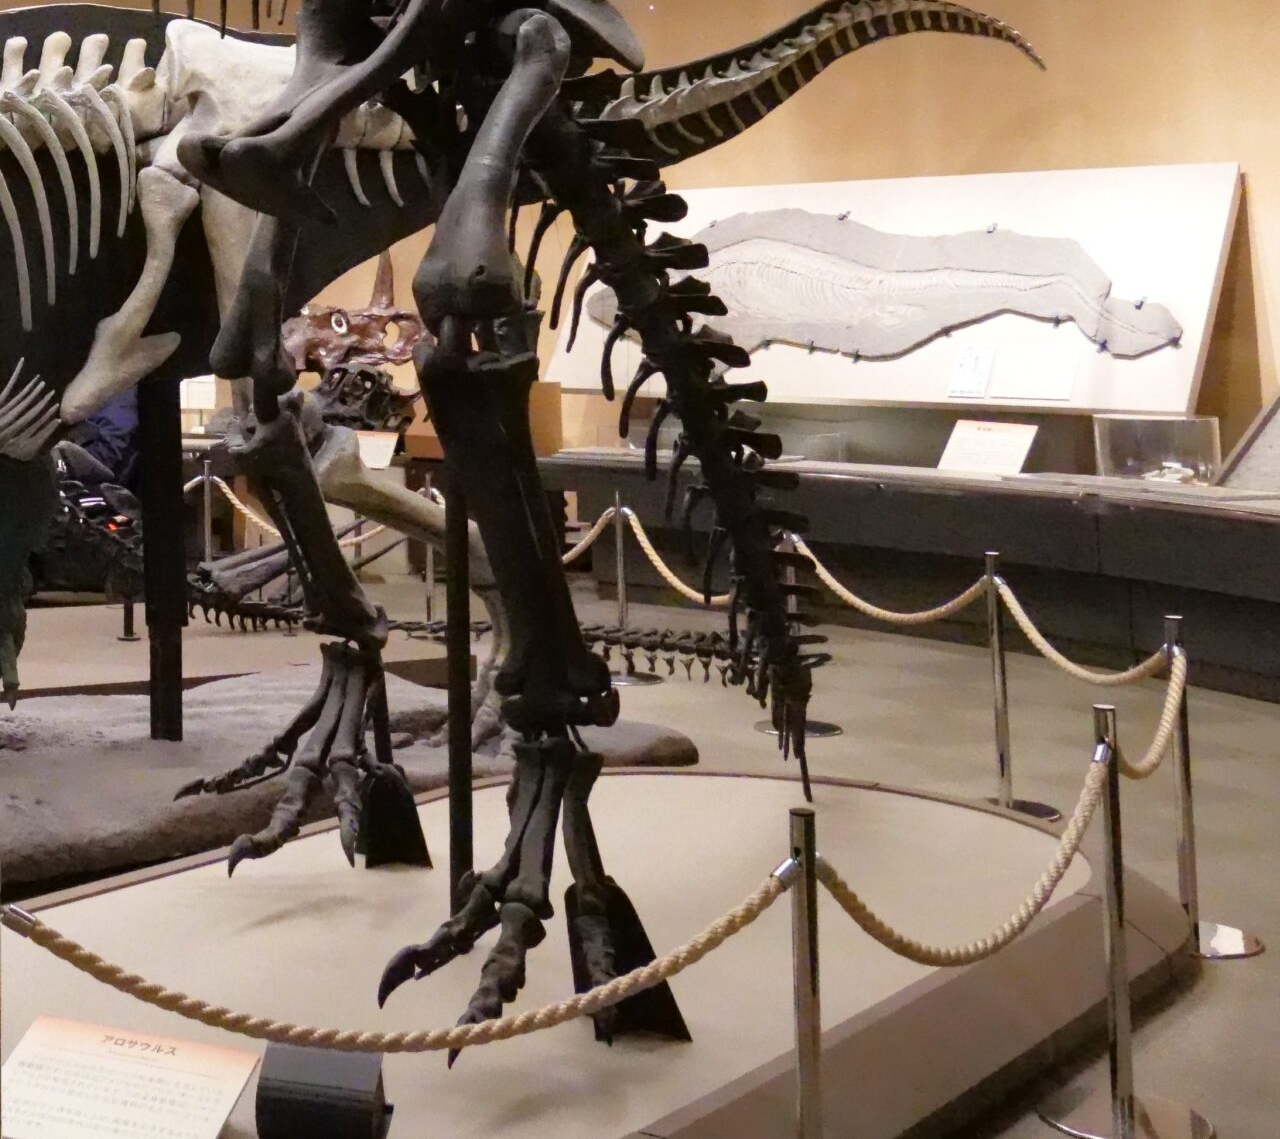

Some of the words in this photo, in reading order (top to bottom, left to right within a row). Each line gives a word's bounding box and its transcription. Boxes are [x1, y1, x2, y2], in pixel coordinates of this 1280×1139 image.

[102, 1035, 177, 1056] アロサウルス
